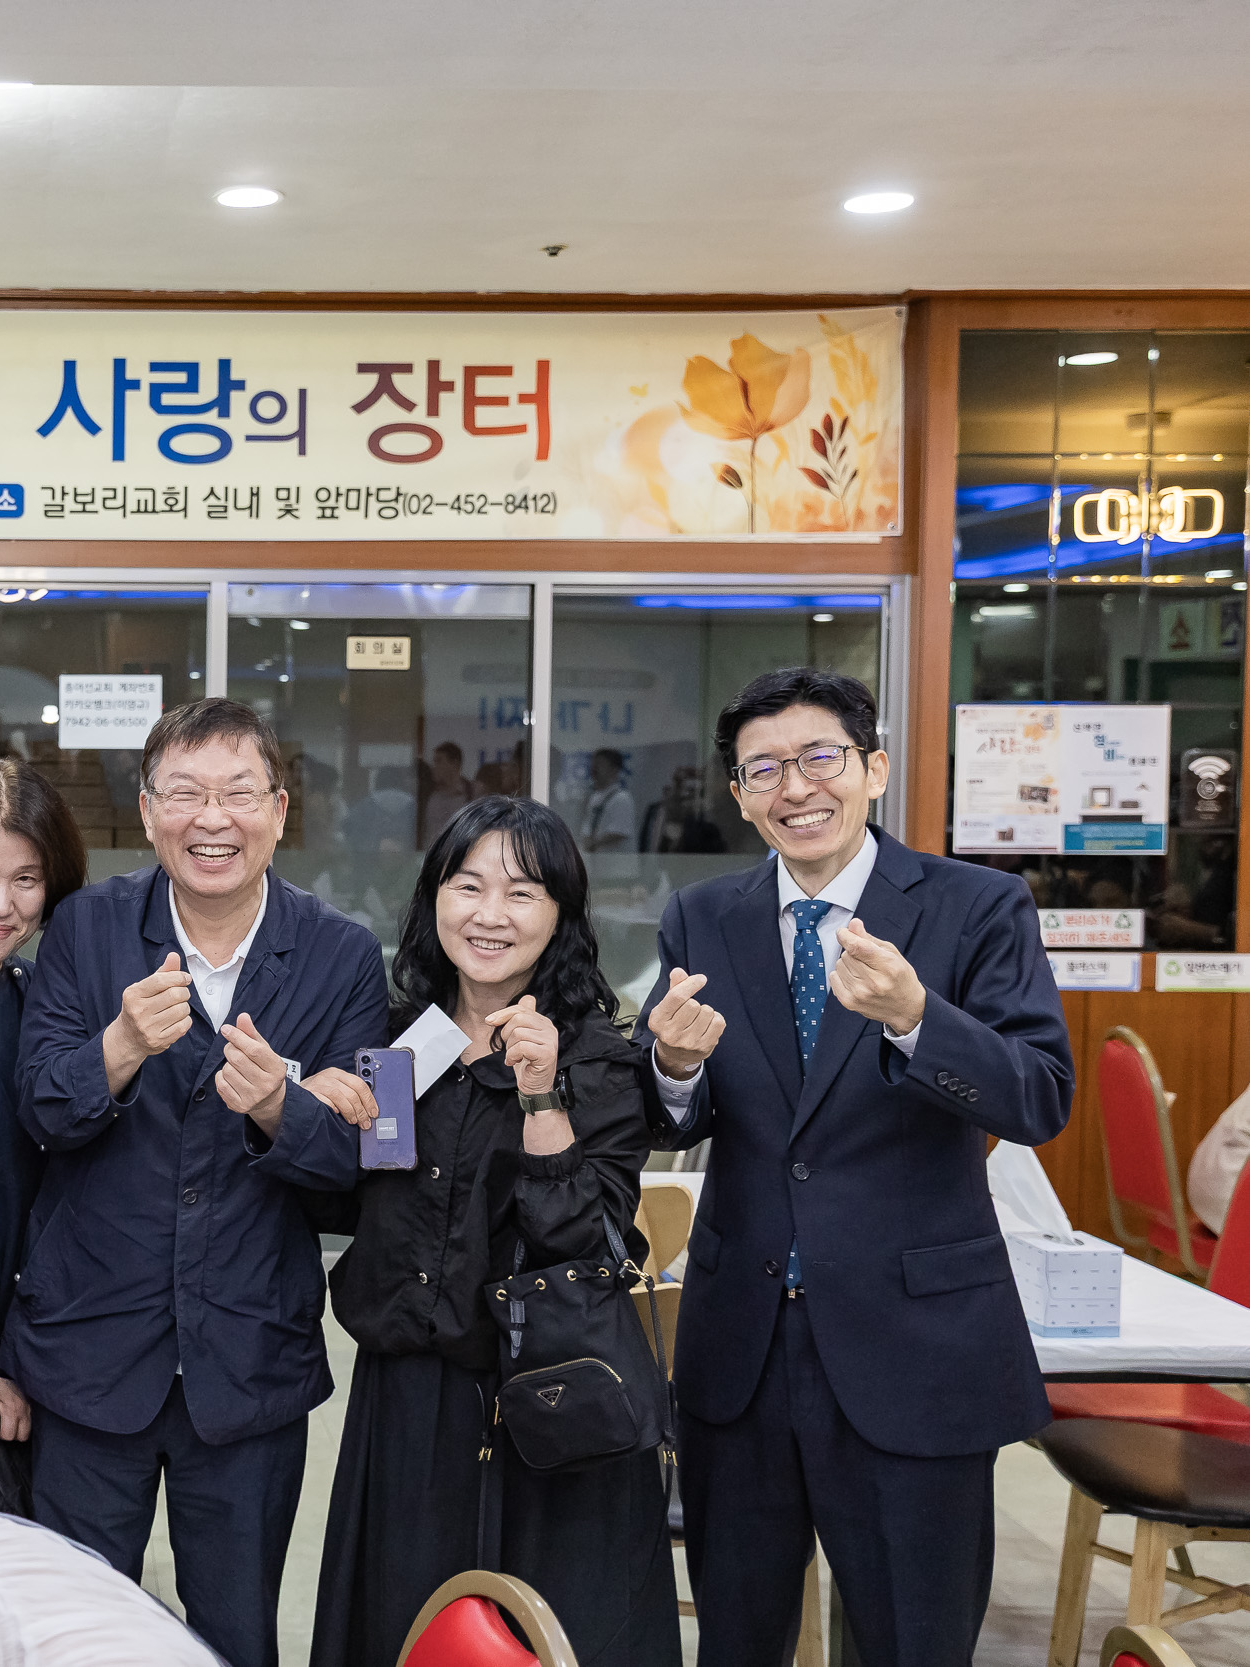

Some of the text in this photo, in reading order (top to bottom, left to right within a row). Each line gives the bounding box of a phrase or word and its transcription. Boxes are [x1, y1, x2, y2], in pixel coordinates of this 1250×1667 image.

[36, 358, 551, 465] 사랑의 장터
[41, 486, 189, 520] 갈보리교회
[203, 486, 261, 520] 실내
[275, 487, 301, 520] 및
